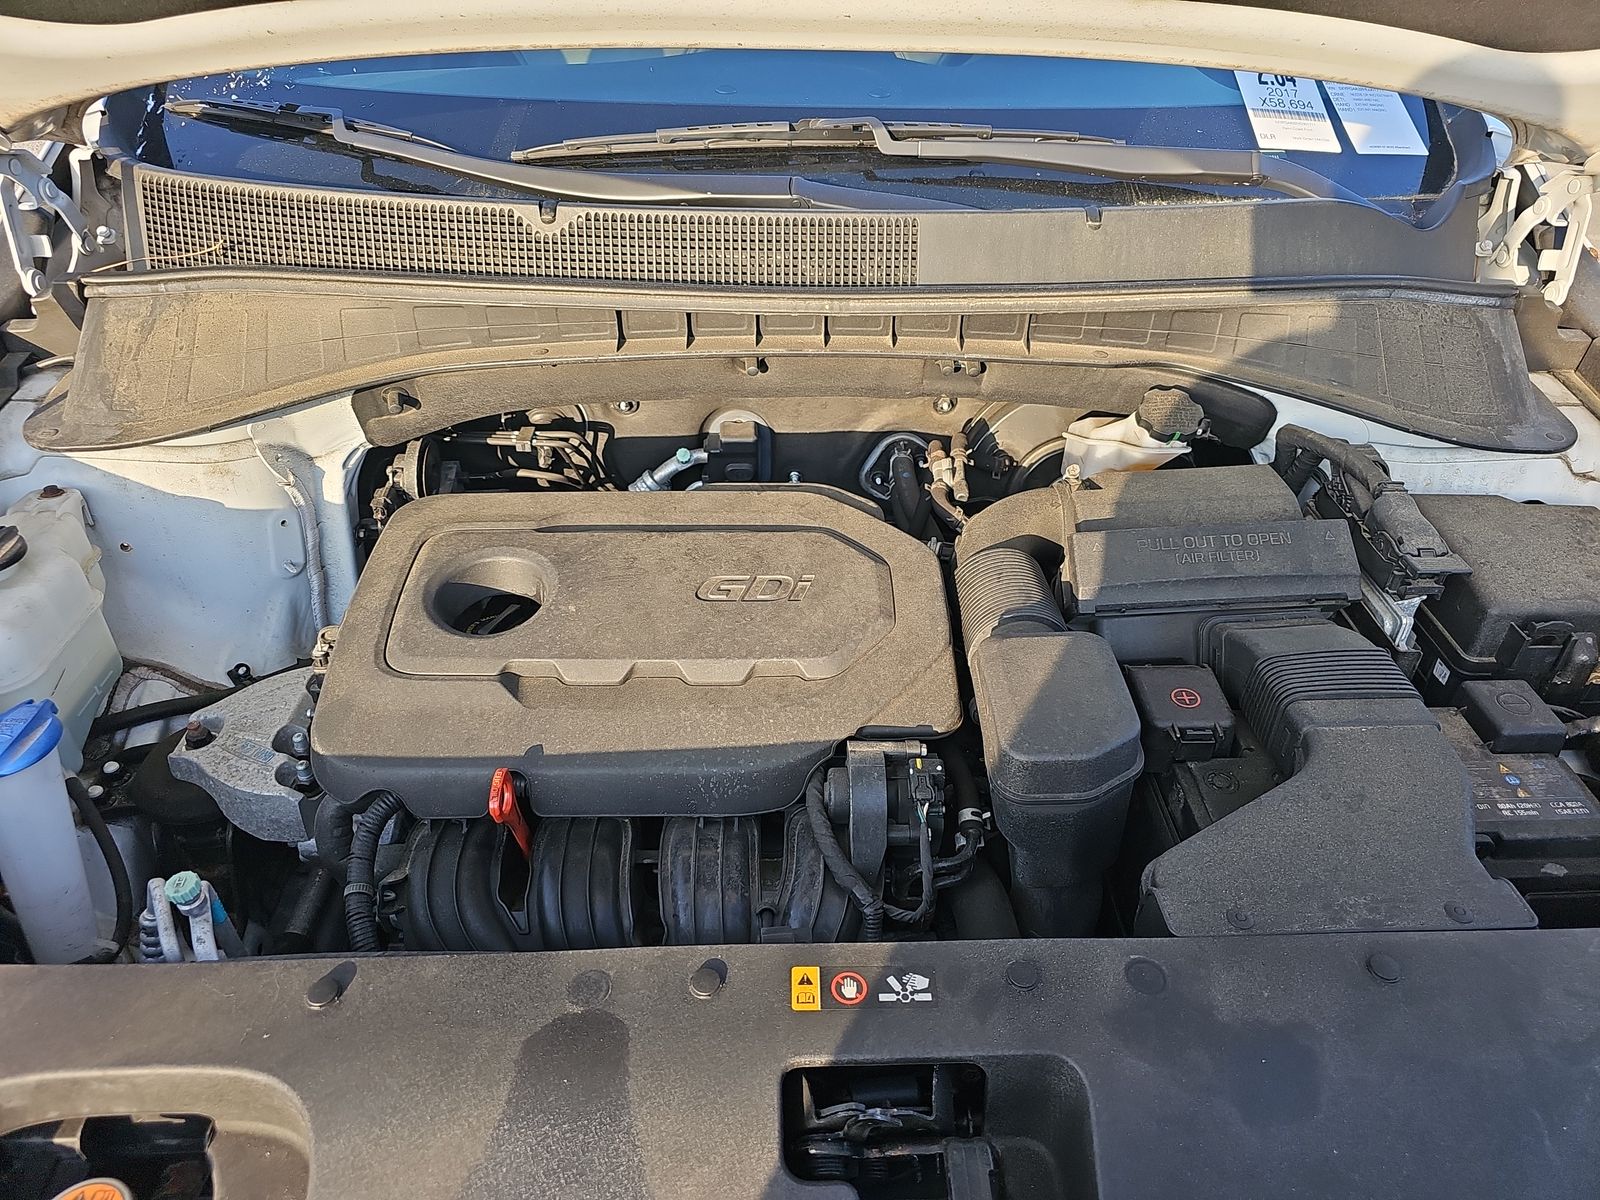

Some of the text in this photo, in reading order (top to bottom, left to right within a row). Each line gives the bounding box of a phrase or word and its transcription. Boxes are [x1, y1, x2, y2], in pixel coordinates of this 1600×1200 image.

[1266, 87, 1298, 98] 2017
[1136, 531, 1292, 552] PULL OUT TO OPEN
[695, 574, 816, 602] GDi
